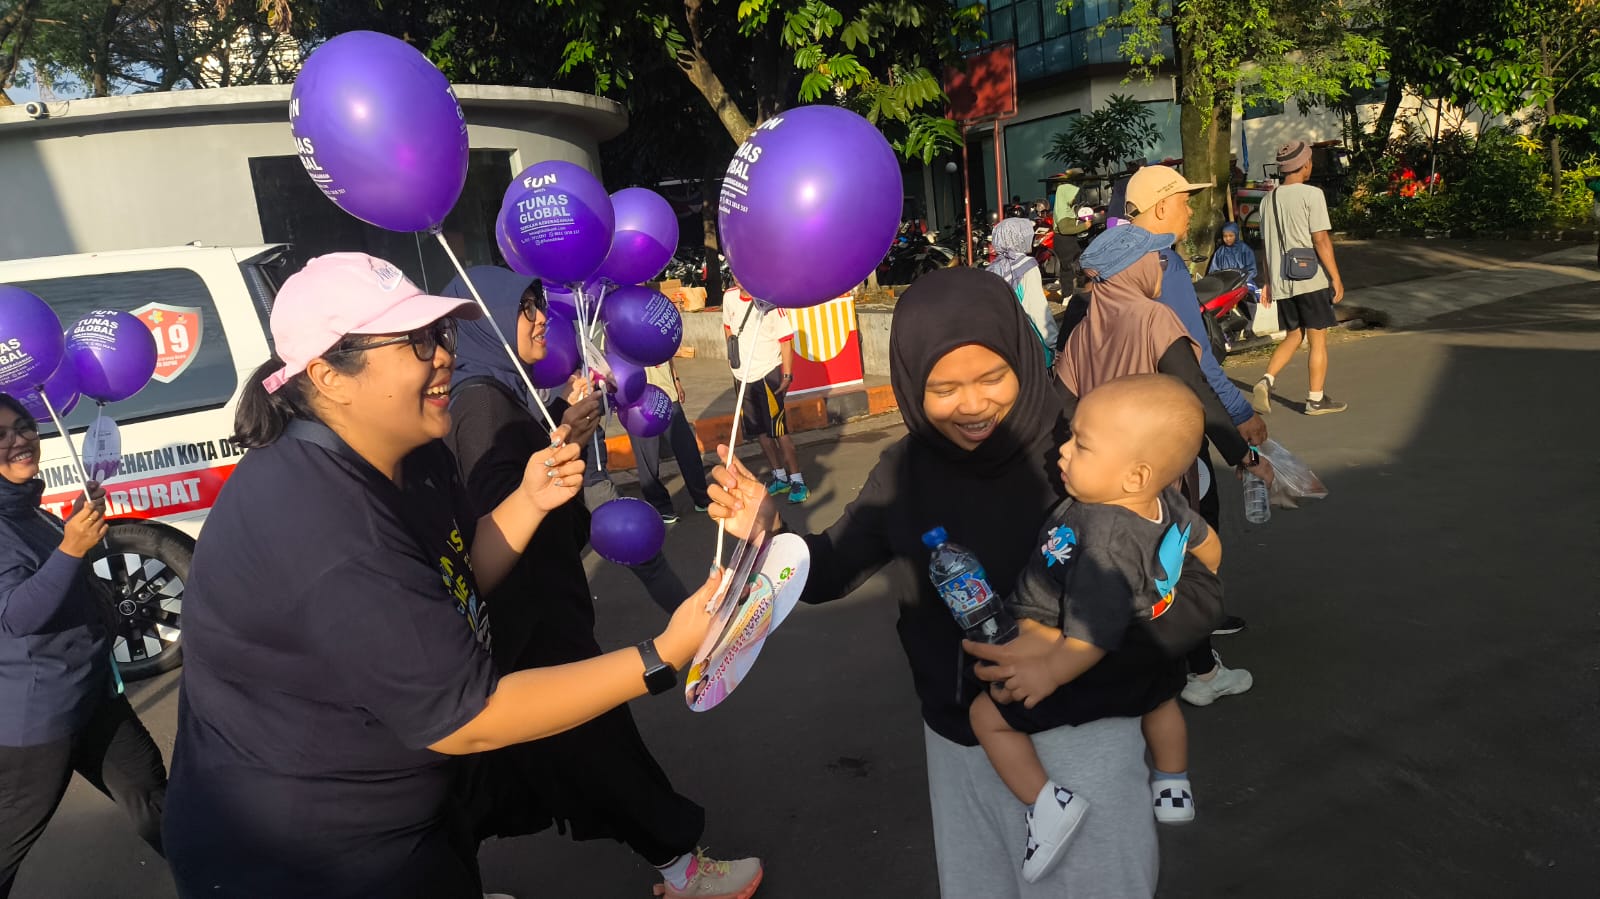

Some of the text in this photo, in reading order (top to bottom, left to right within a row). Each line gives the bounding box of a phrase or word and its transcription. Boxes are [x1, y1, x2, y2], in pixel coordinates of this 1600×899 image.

[523, 174, 557, 188] FUN
[517, 194, 569, 212] TUNAS
[520, 207, 571, 224] GLOBAL
[74, 325, 115, 336] GLOBAL
[79, 318, 118, 329] TUNAS
[177, 441, 218, 466] KOTA
